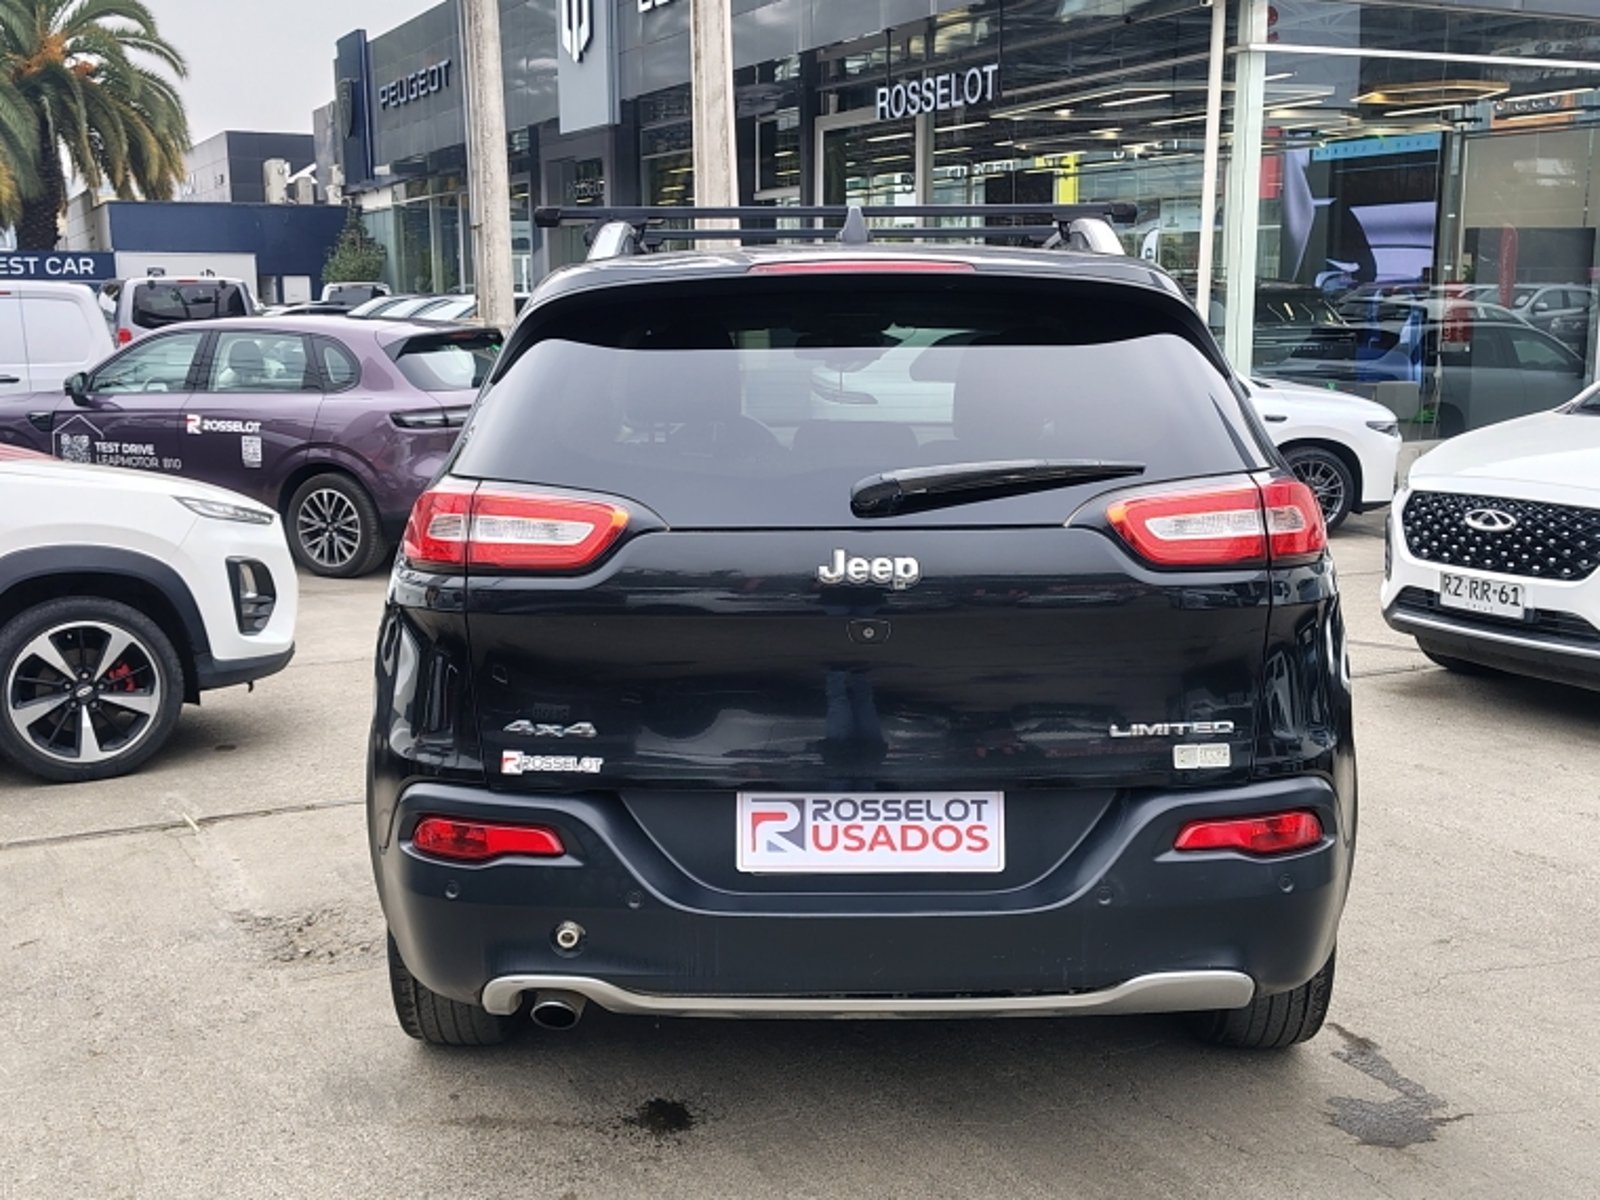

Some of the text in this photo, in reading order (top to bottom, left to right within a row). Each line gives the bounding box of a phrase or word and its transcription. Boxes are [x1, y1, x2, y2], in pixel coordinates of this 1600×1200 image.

[379, 59, 450, 110] PEUGEOT
[876, 64, 999, 120] ROSSELOT
[45, 257, 95, 275] CAR
[203, 419, 262, 433] ROSSELOT
[94, 441, 155, 456] TEST DRIVE
[818, 549, 919, 590] Jeep
[1109, 721, 1235, 738] LIMITED
[522, 756, 603, 773] ROSSELOT
[812, 799, 988, 822] ROSSELOT
[812, 824, 990, 853] USADOS
